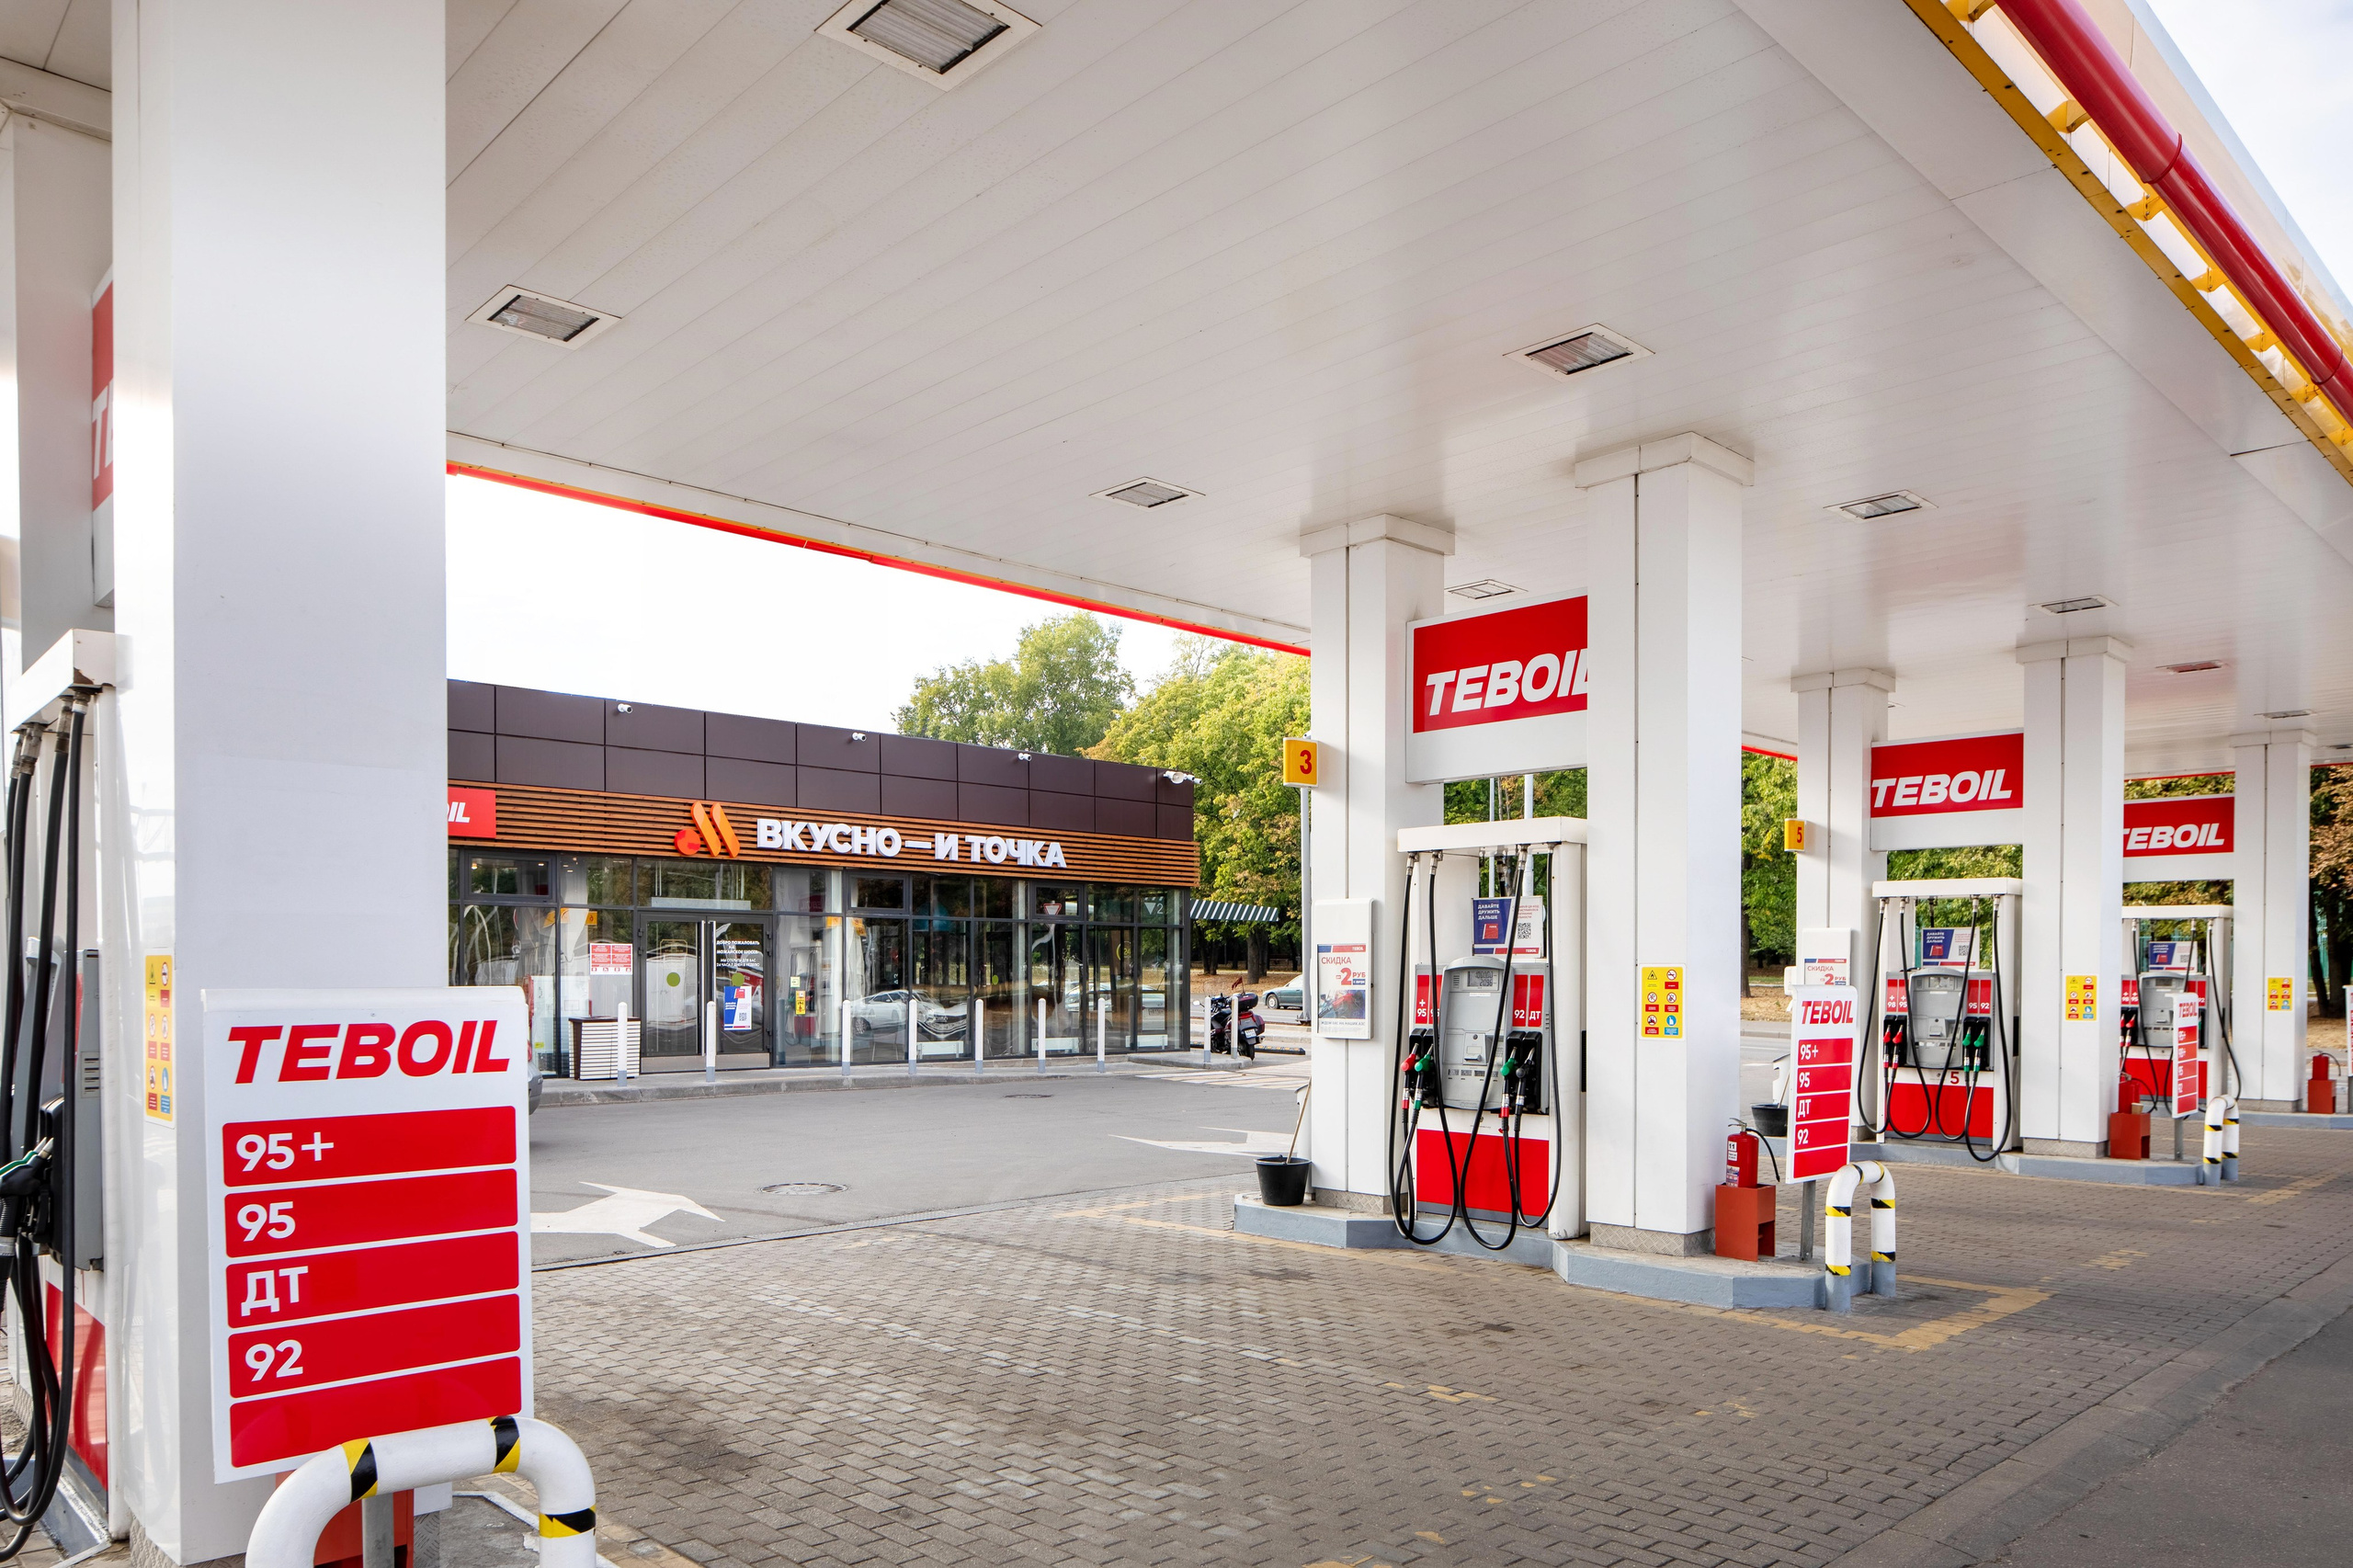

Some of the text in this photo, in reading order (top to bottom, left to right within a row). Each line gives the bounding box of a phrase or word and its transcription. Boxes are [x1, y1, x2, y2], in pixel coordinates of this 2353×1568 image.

[1426, 648, 1587, 716] TEBOIL
[1300, 749, 1313, 775] 3
[1871, 768, 2012, 808] TEBOIL
[756, 818, 903, 858] ВКУСНО
[934, 833, 959, 861] И
[965, 835, 1067, 868] ТОЧКА
[1797, 826, 1802, 844] 5
[2122, 823, 2225, 850] EBOIL
[1321, 957, 1352, 965] СКИДКА
[1340, 967, 1352, 985] 2
[1824, 973, 1835, 985] 2
[1416, 1008, 1427, 1017] 95
[1514, 1009, 1525, 1019] 92
[1529, 1011, 1541, 1020] ДТ
[1802, 1000, 1854, 1025] TEBOIL
[228, 1020, 510, 1085] TEBOIL
[1800, 1044, 1819, 1061] 95+
[1799, 1072, 1811, 1088] 95
[1949, 1071, 1960, 1085] 5
[1797, 1098, 1812, 1119] ДТ
[1797, 1129, 1809, 1145] 92
[236, 1131, 335, 1172] 95+
[237, 1200, 296, 1242] 95
[241, 1266, 309, 1317] ДТ
[245, 1339, 303, 1381] 92
